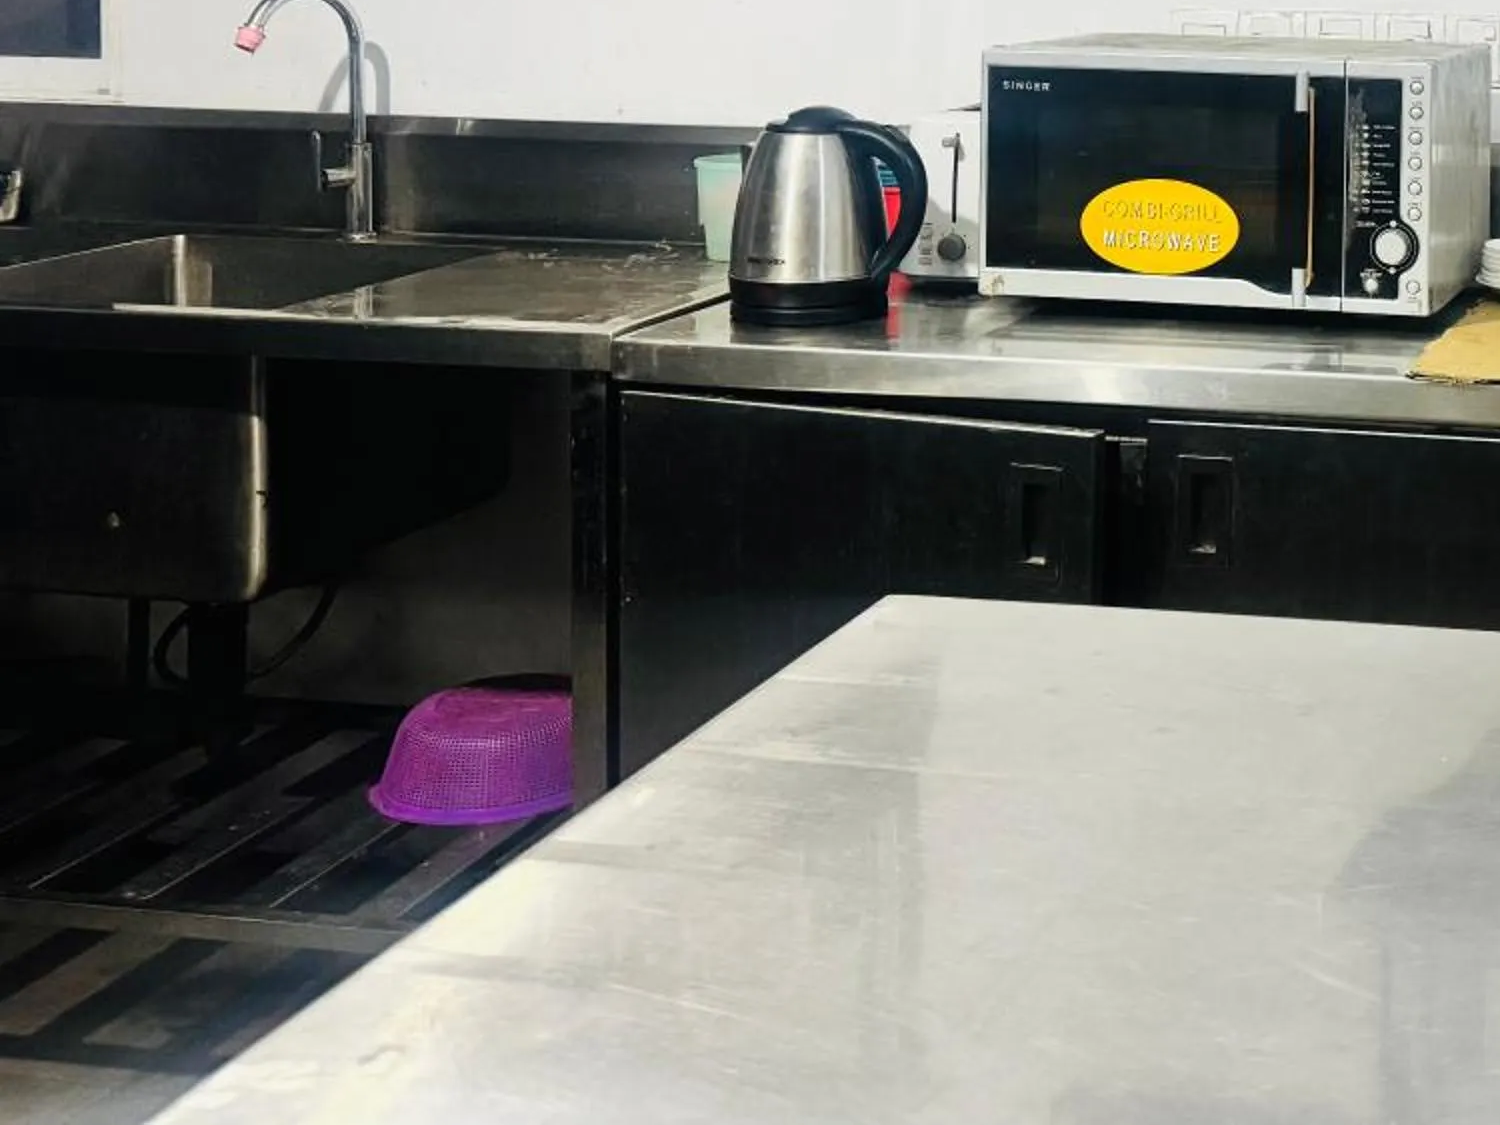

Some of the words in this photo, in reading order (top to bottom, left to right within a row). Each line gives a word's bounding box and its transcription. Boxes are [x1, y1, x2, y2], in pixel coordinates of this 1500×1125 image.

[1003, 80, 1051, 92] SINGER
[1102, 200, 1223, 224] COMBI-GRILL
[1102, 229, 1221, 253] MICROWAVE
